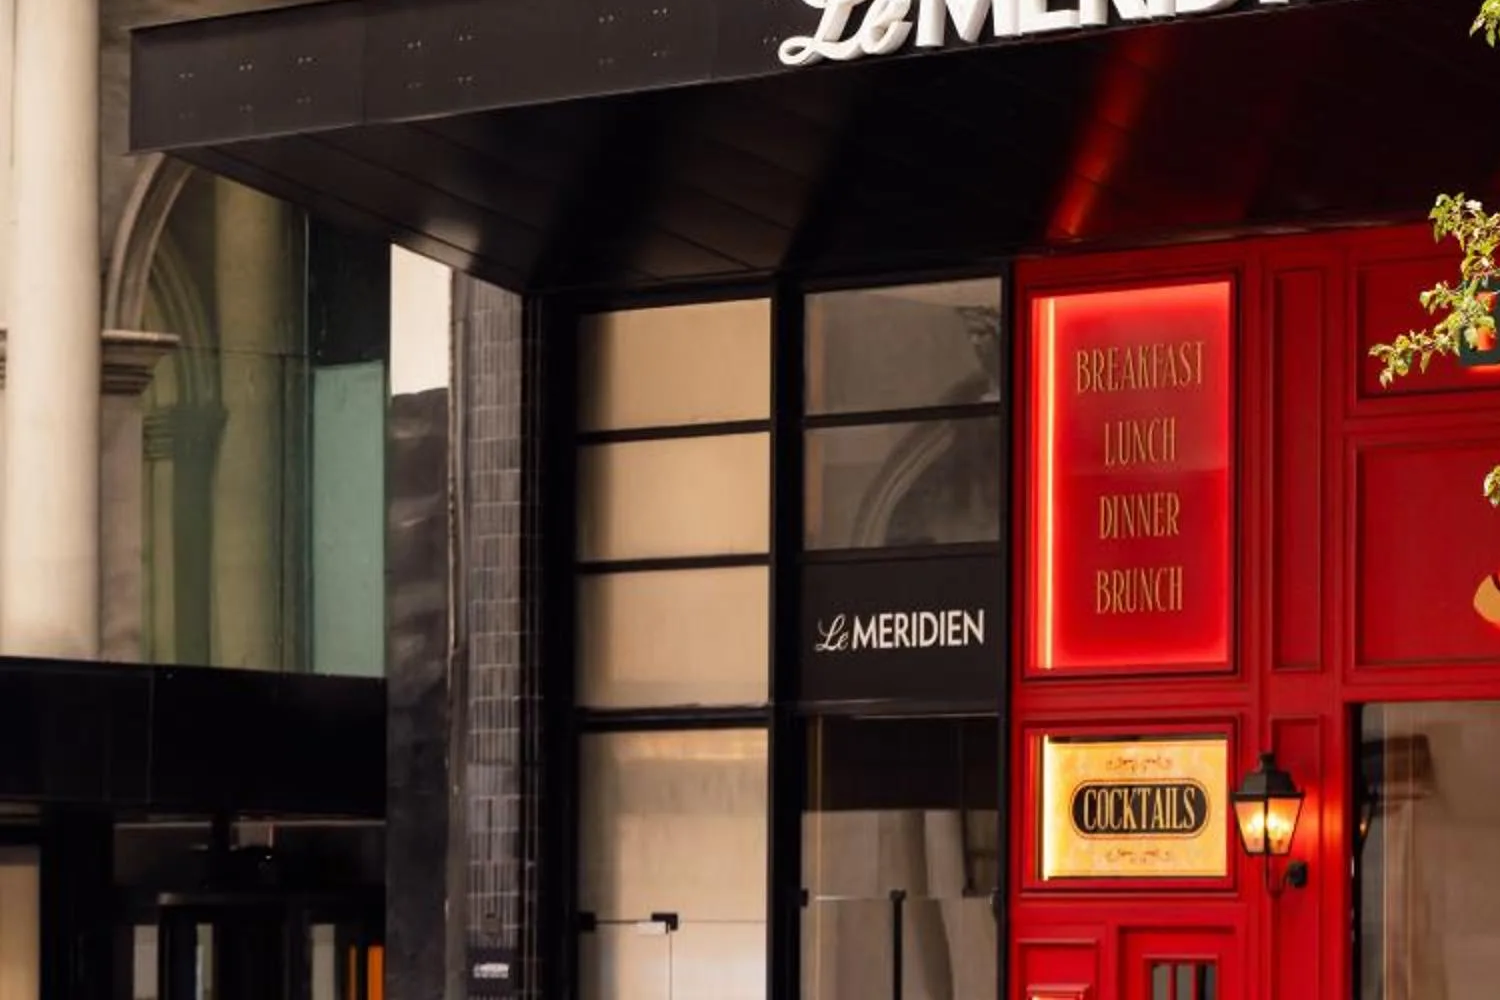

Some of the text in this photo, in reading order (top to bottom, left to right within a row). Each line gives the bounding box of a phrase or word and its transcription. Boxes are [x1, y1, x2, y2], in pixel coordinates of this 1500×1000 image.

[1075, 340, 1206, 395] BREAKFAST
[1103, 416, 1177, 467] LUNCH
[1098, 491, 1181, 541] DINNER
[1095, 565, 1184, 616] BRUNCH
[815, 608, 985, 652] Le MERIDIEN
[1082, 786, 1197, 832] COCKTAILS
